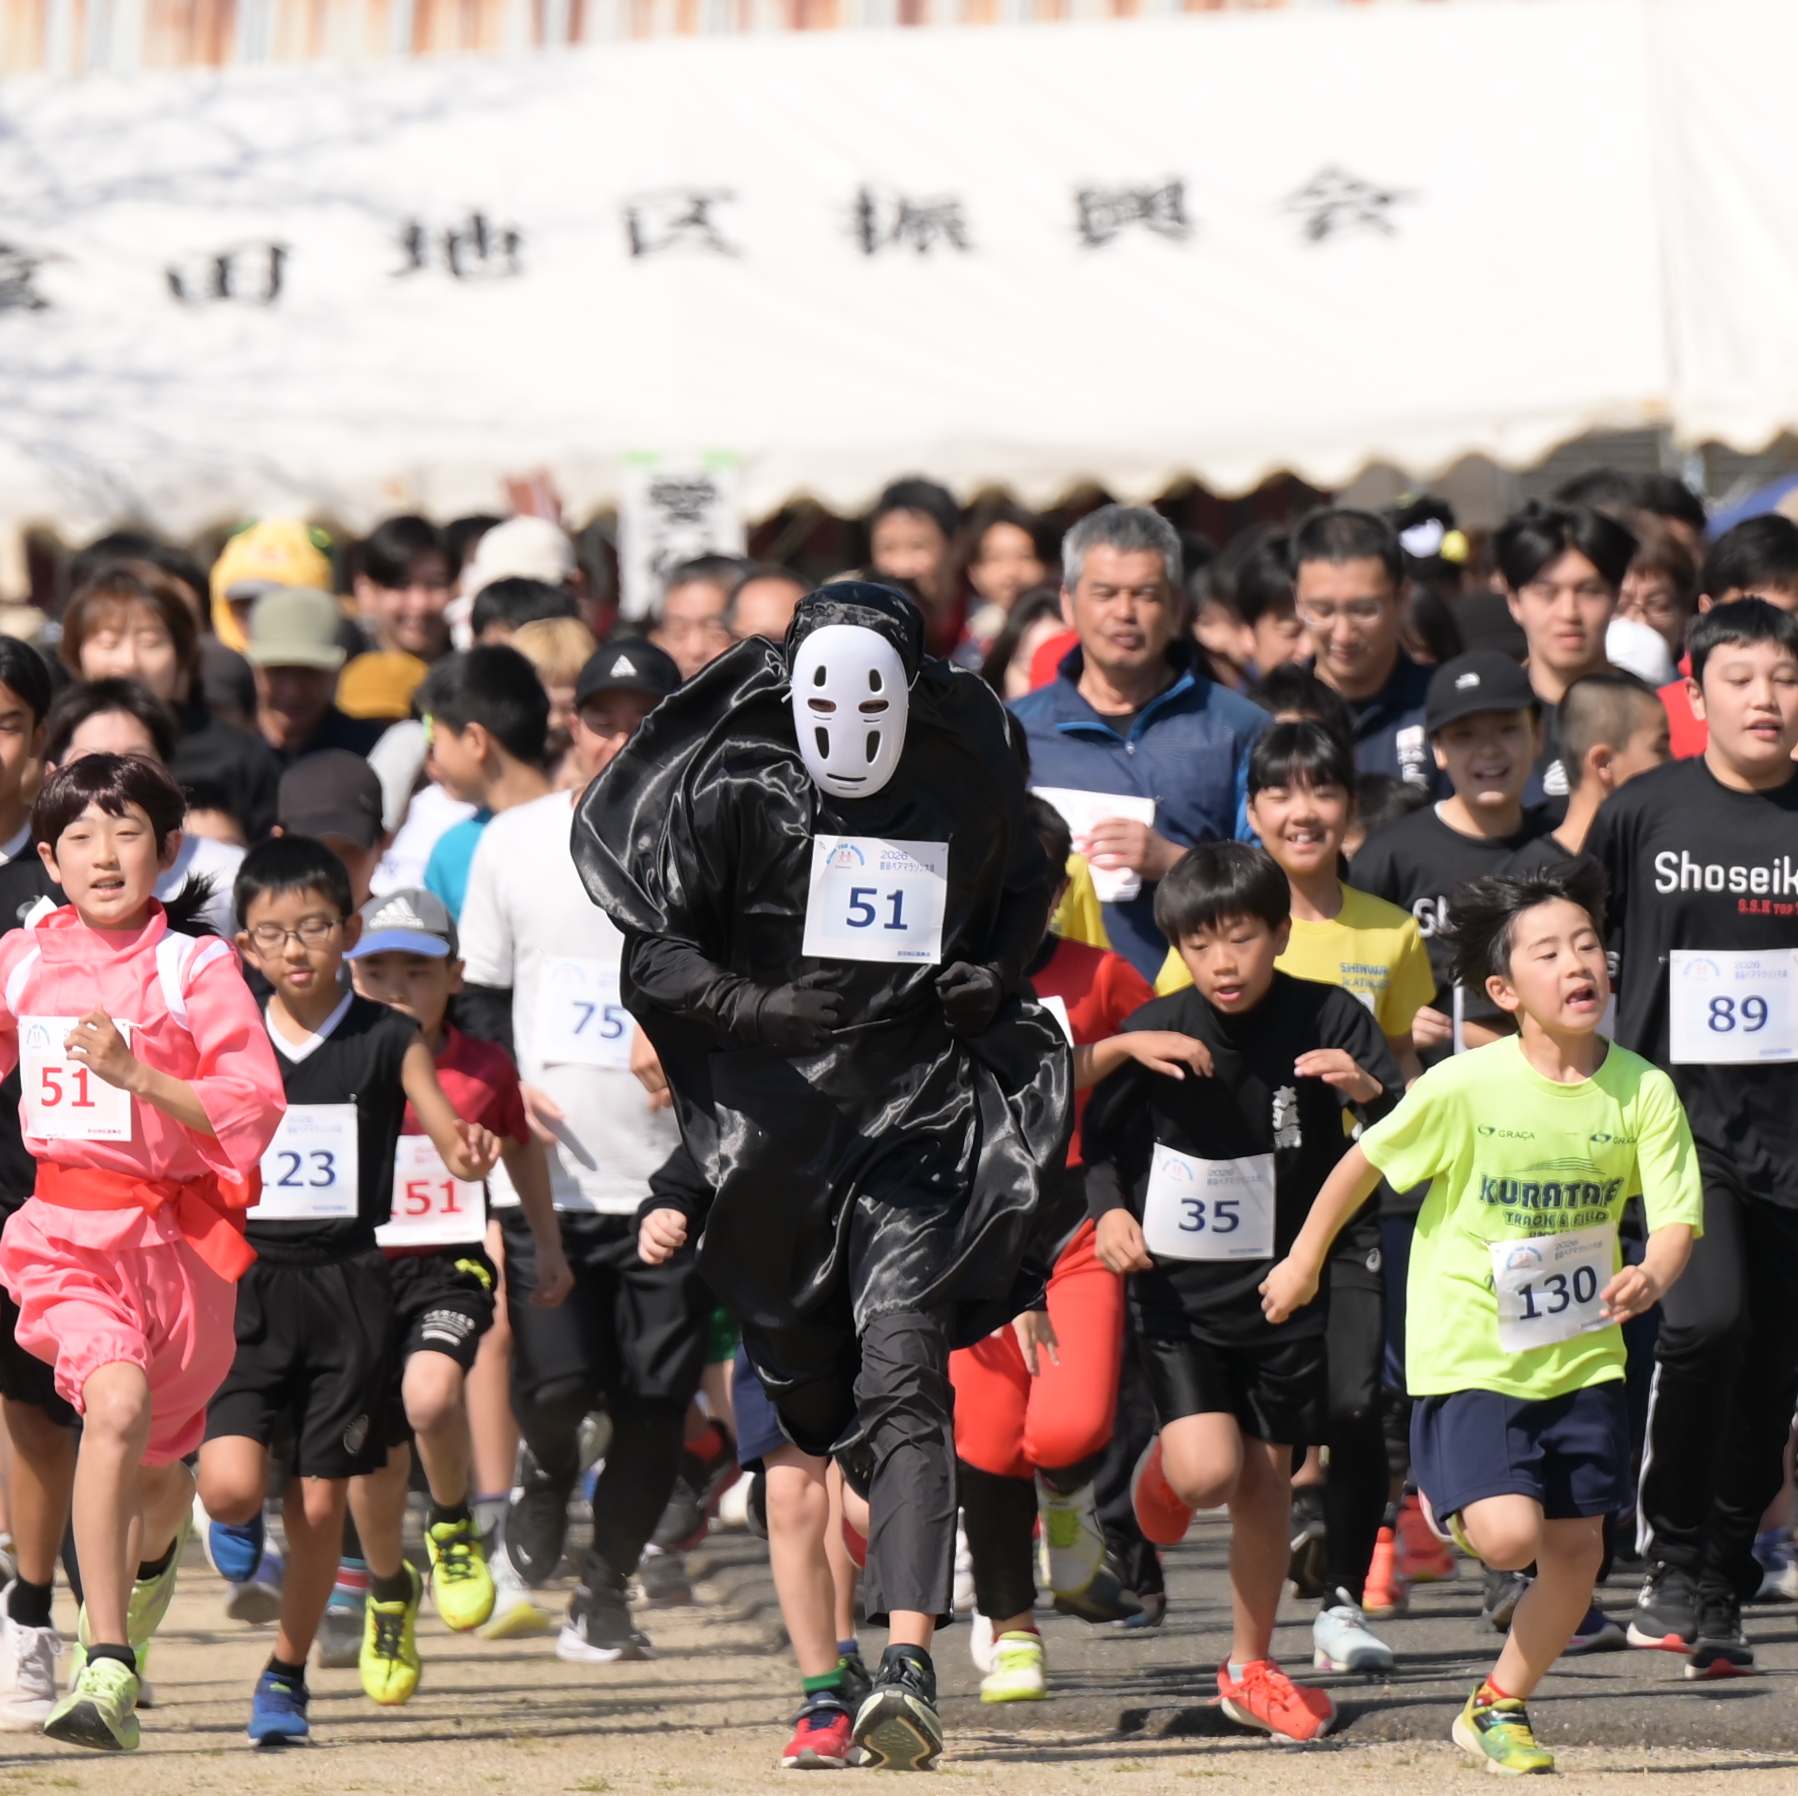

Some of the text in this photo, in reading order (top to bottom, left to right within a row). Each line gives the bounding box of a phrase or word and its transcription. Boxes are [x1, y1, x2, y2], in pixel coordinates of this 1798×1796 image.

[880, 850, 909, 861] 2026
[846, 886, 908, 931] 51
[572, 1000, 625, 1040] 75
[1707, 994, 1769, 1033] 89
[41, 1067, 96, 1108] 51
[262, 1149, 336, 1188] 23
[392, 1179, 462, 1216] 51
[1178, 1197, 1240, 1233] 35
[1504, 1210, 1610, 1228] TRACK & FIELD
[1518, 1265, 1597, 1320] 130
